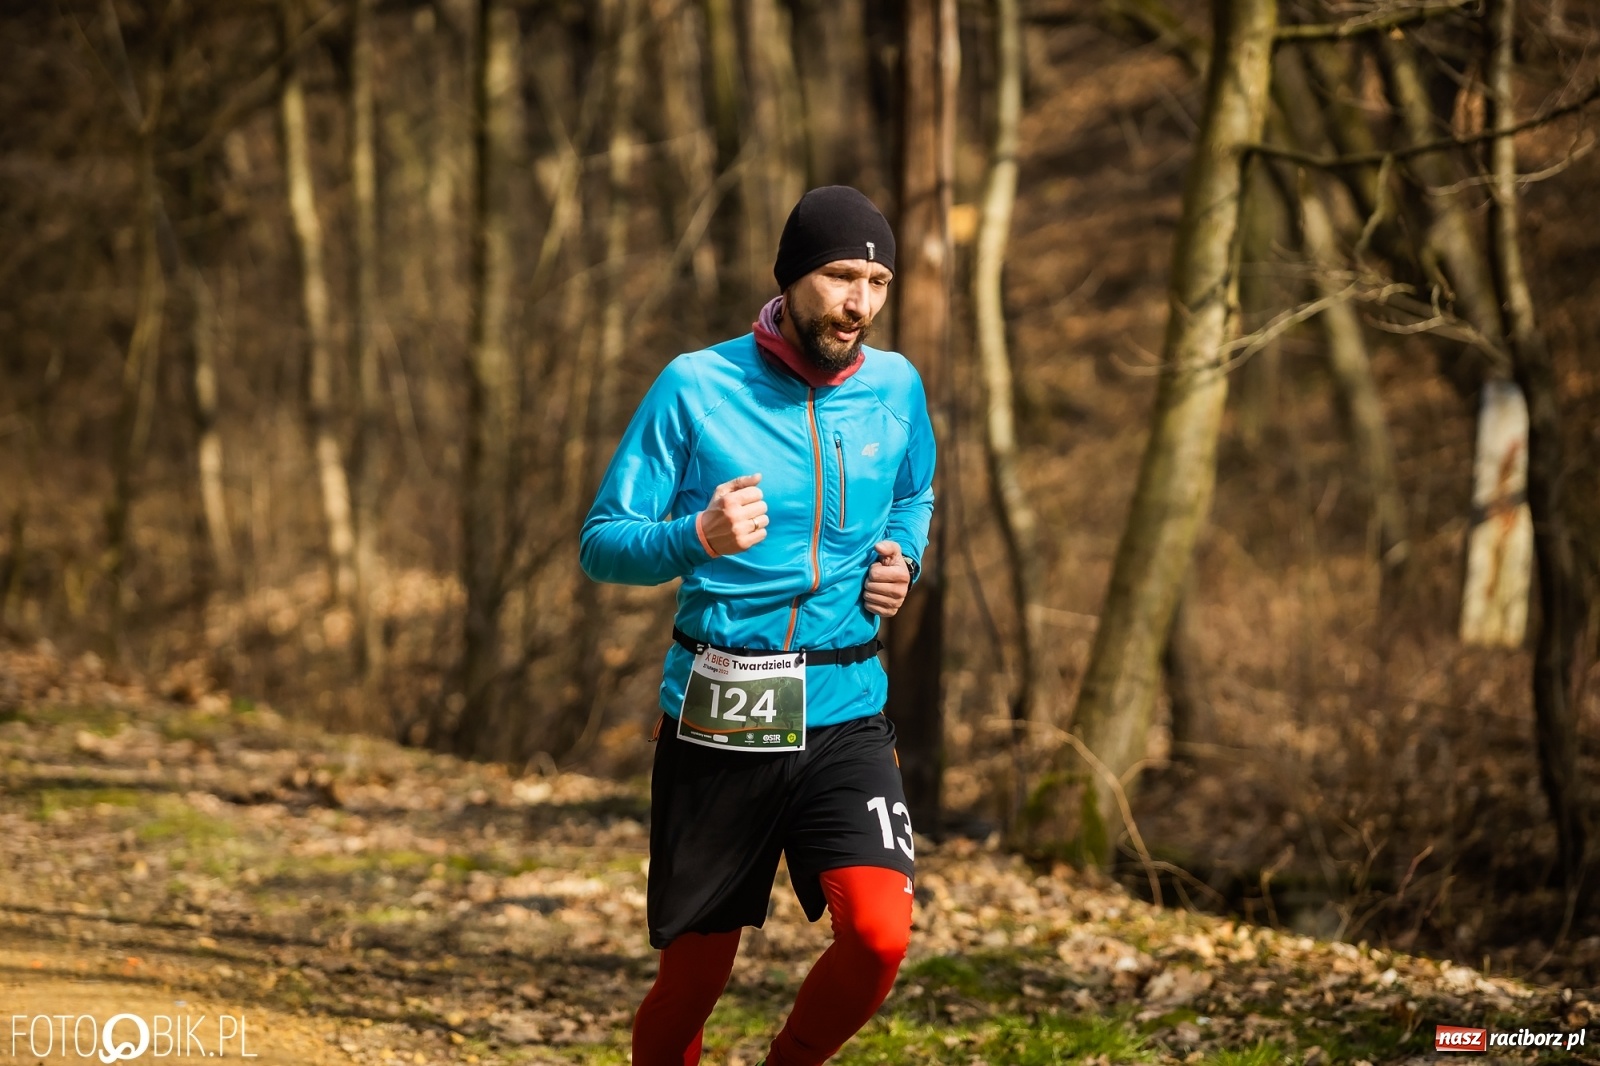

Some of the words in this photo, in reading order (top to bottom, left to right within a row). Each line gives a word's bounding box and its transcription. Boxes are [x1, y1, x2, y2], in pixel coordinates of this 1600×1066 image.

[705, 652, 711, 662] X
[711, 654, 730, 667] BIEG
[732, 659, 791, 671] Twardziela
[710, 683, 777, 723] 124
[867, 797, 914, 861] 13
